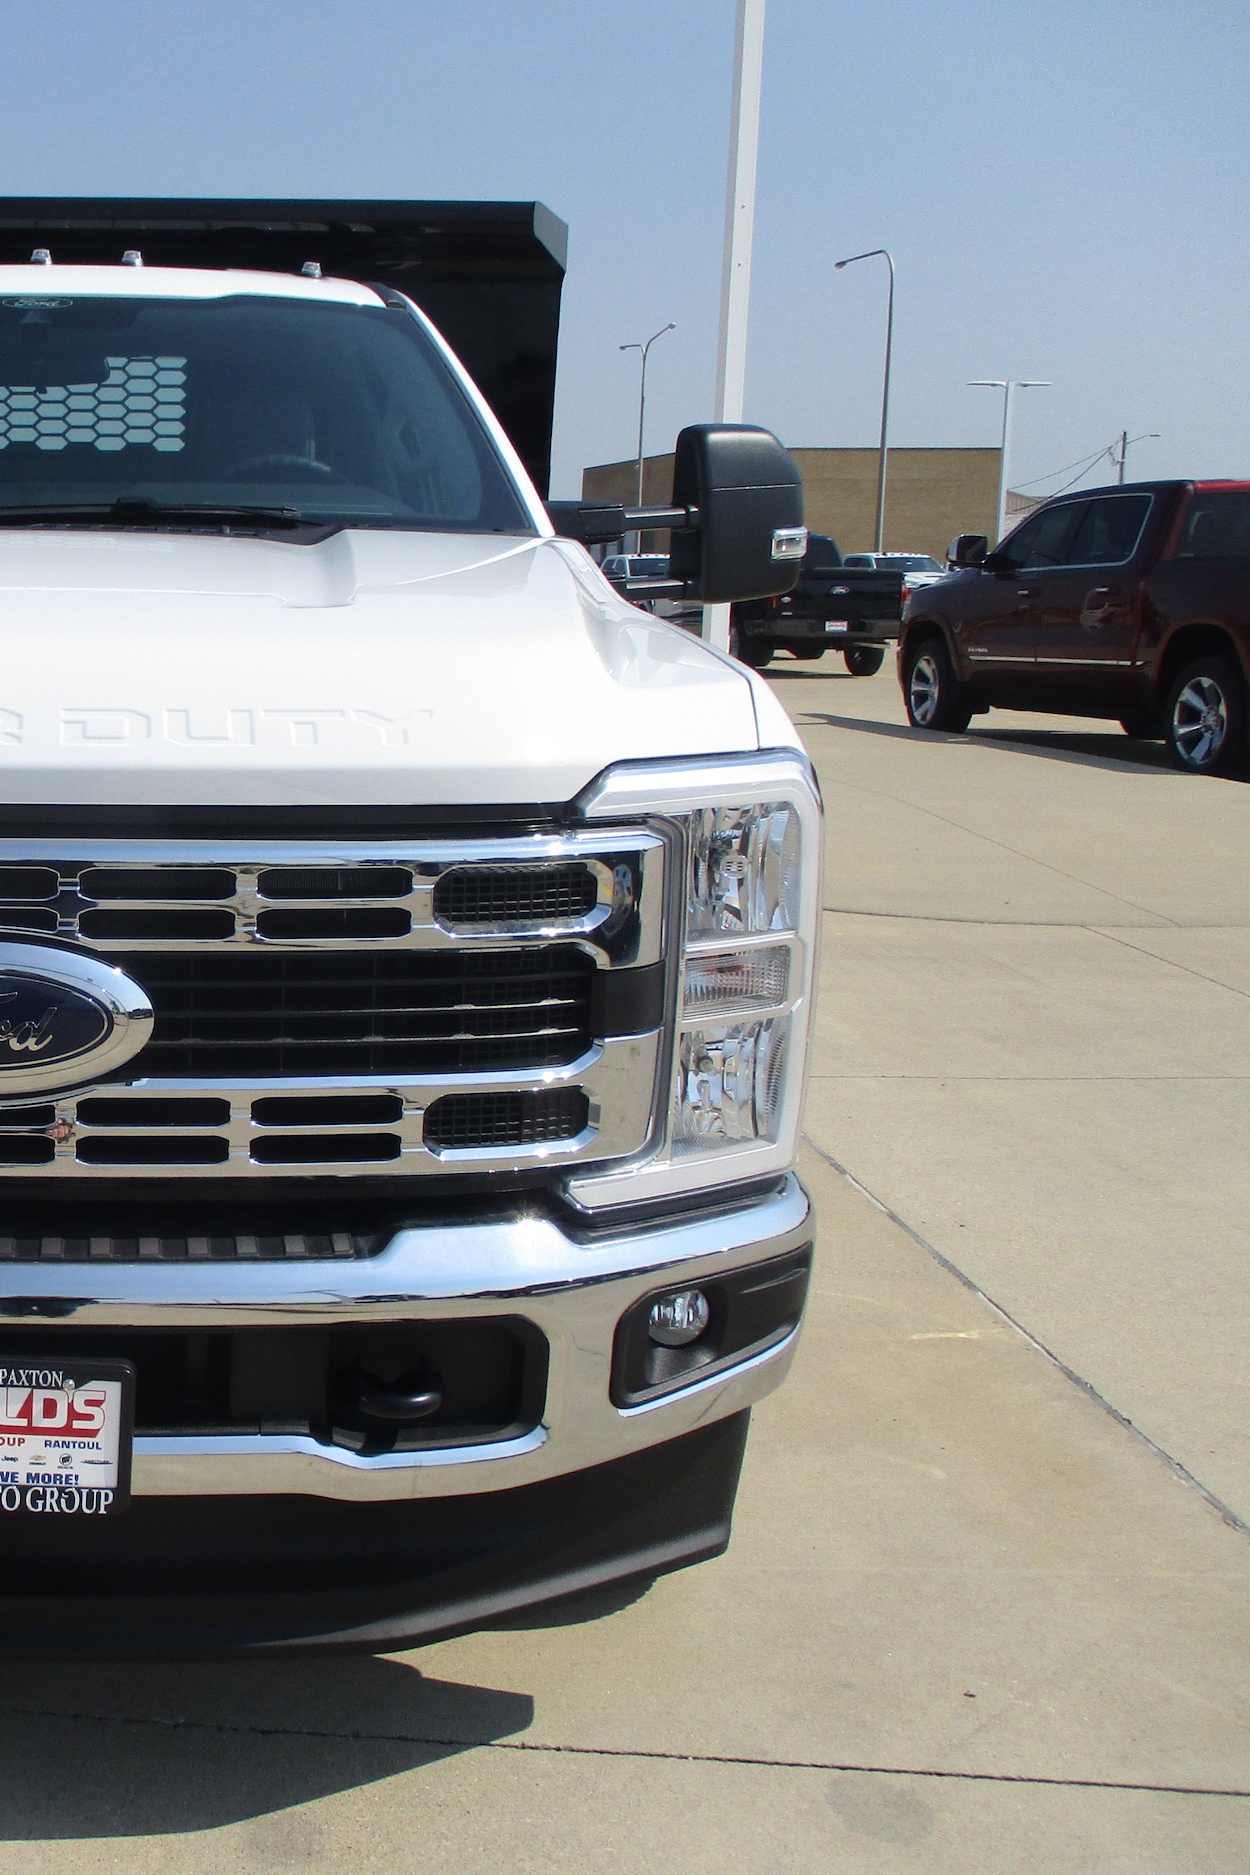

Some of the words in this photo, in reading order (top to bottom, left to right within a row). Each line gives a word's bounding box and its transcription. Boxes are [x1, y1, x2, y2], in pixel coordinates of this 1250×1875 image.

[58, 706, 434, 748] DUTY
[44, 1439, 103, 1450] RANTOUL
[1, 1455, 19, 1463] Jeep
[26, 1472, 80, 1486] MORE!
[25, 1486, 114, 1514] GROUP
